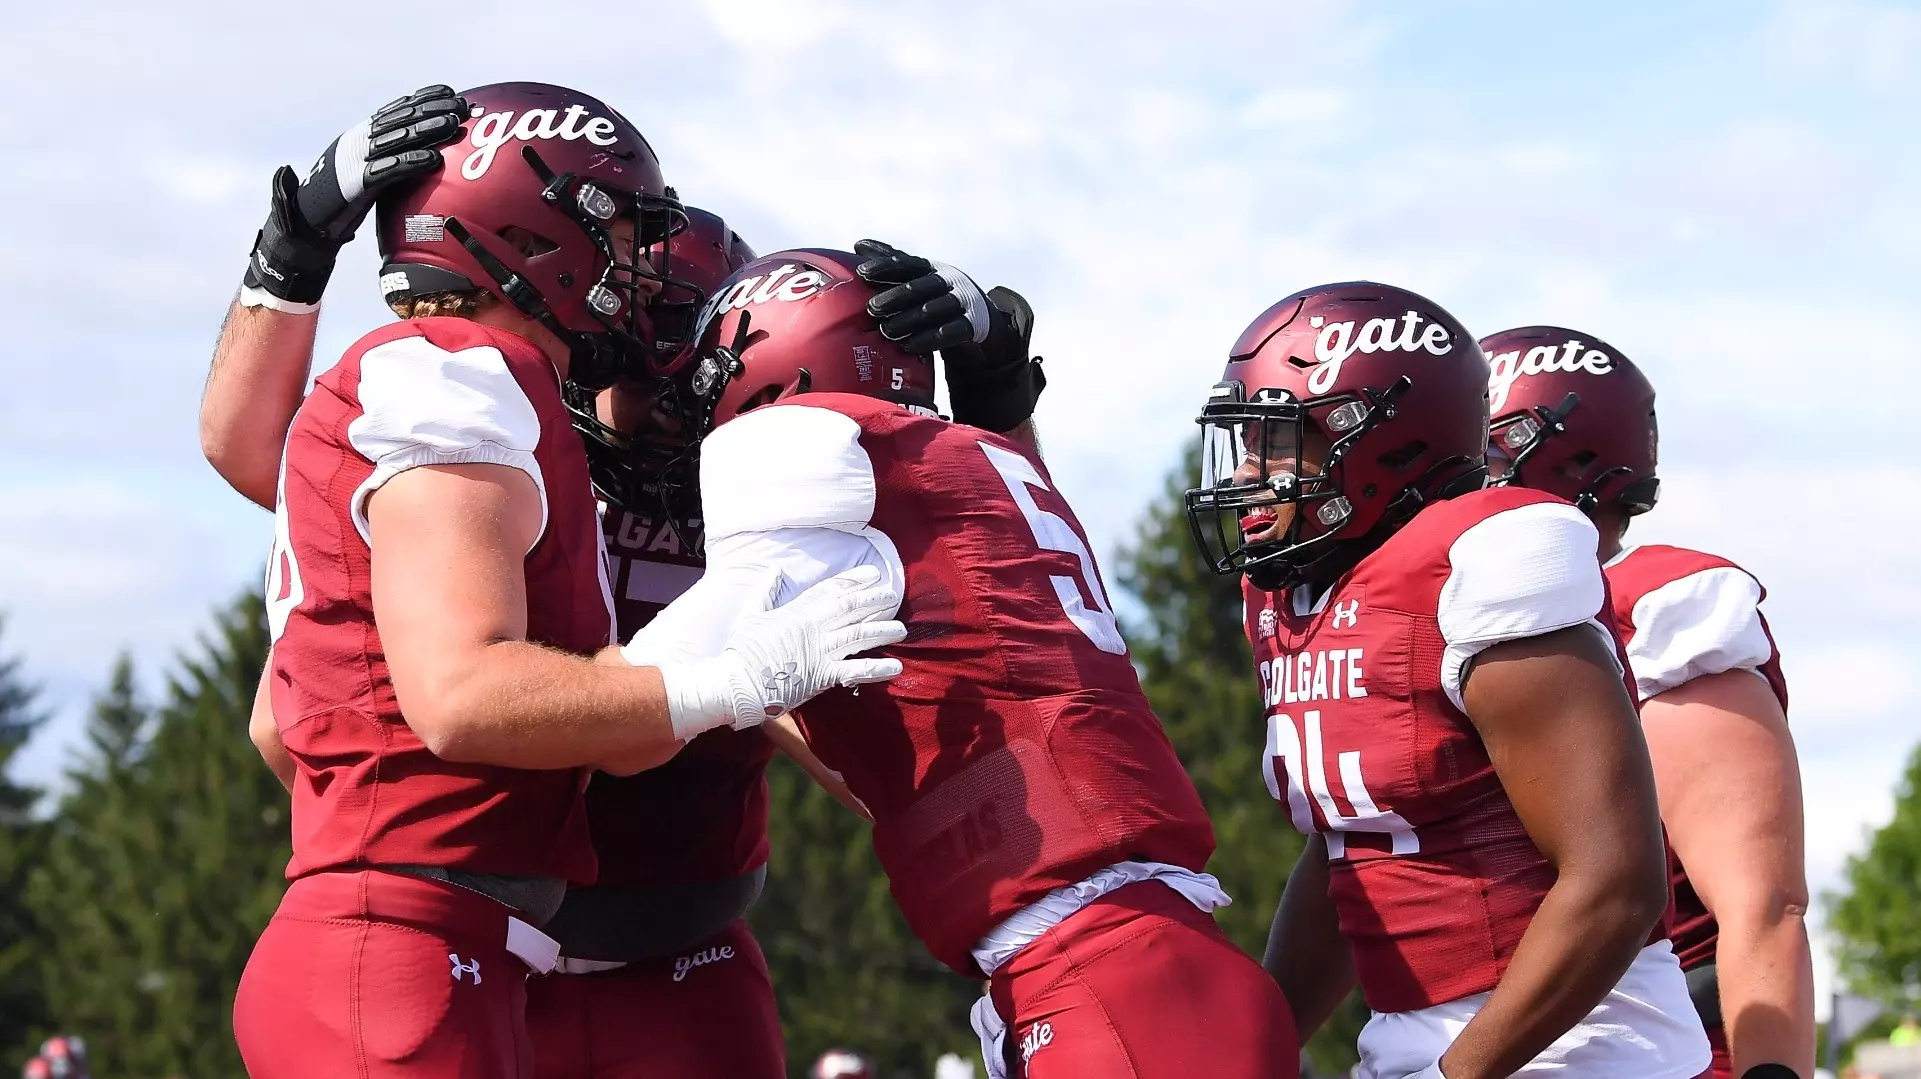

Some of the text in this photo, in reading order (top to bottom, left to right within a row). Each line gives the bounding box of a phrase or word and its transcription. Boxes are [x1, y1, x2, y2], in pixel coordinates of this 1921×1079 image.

[461, 104, 618, 181] 'gate
[891, 367, 904, 390] 5
[1308, 310, 1454, 396] 'gate
[976, 440, 1127, 656] 5
[1259, 647, 1369, 709] COLGATE
